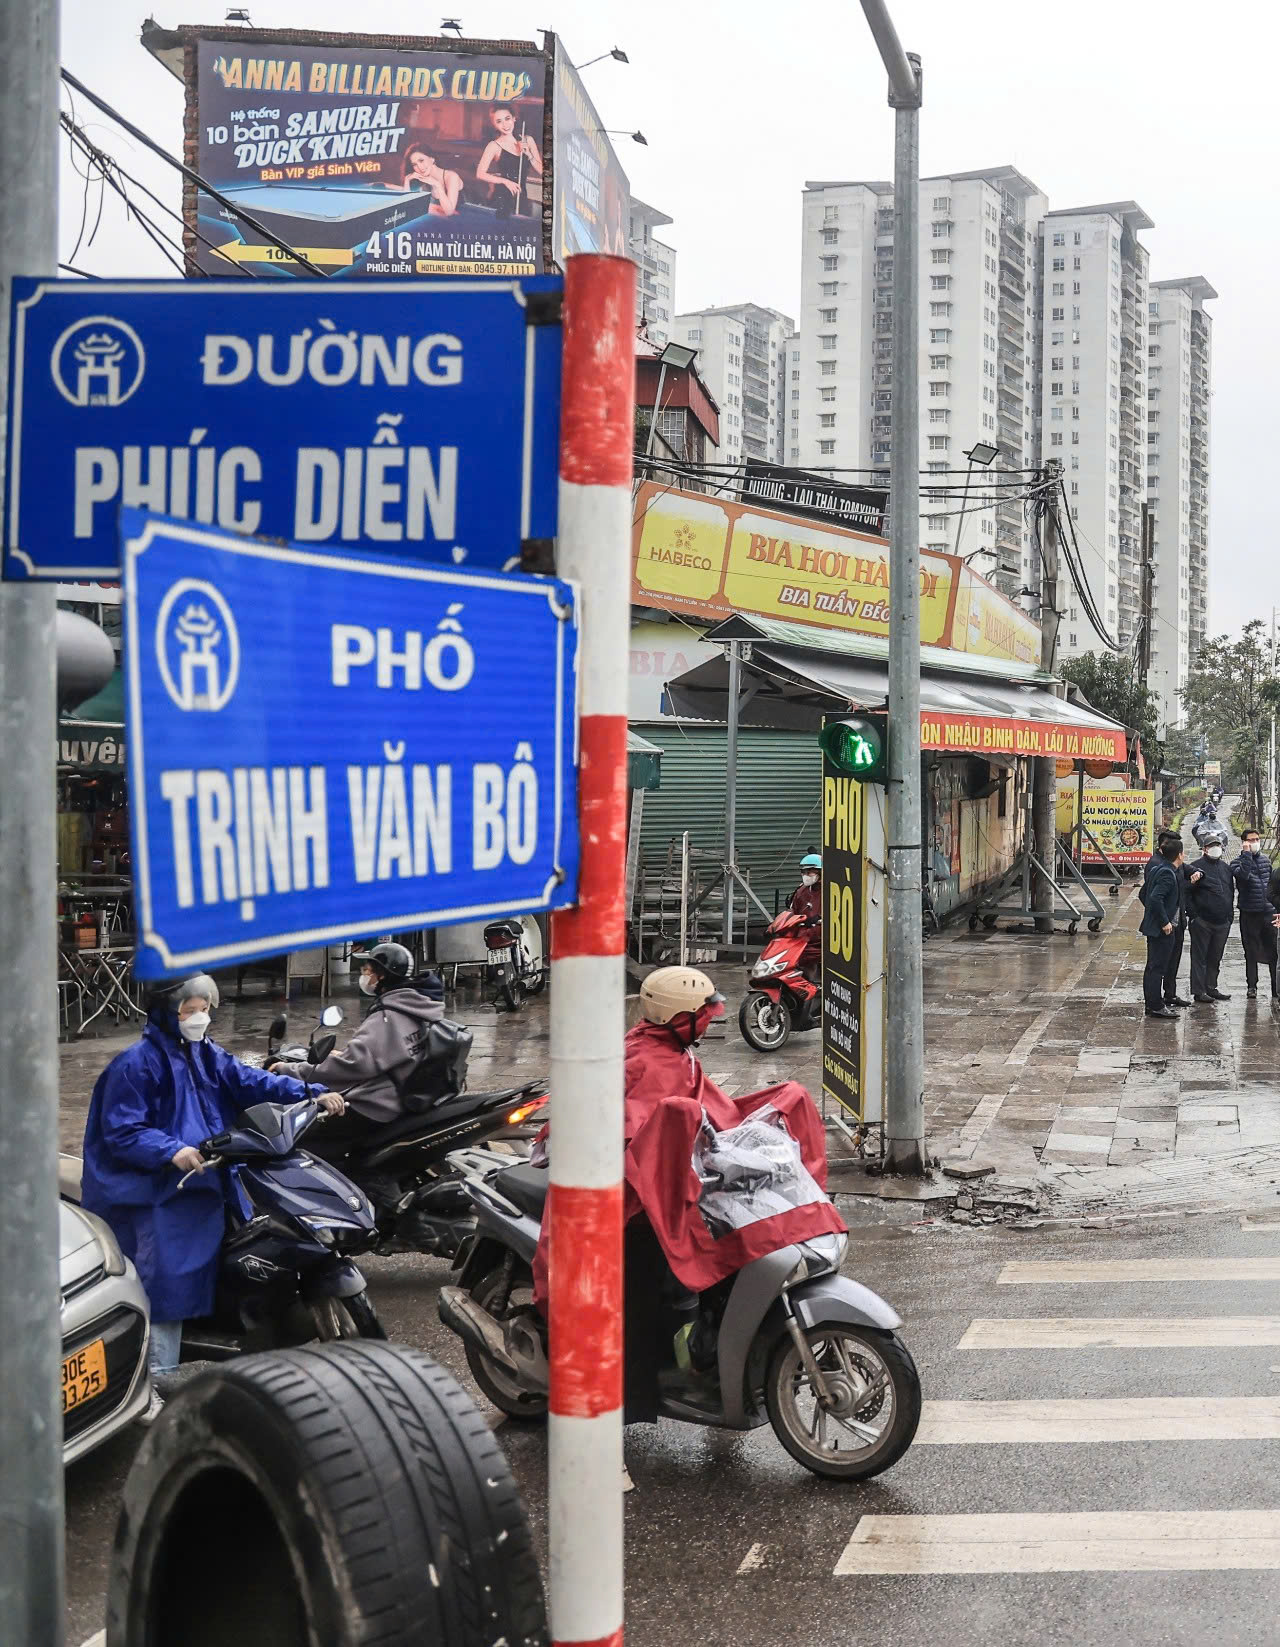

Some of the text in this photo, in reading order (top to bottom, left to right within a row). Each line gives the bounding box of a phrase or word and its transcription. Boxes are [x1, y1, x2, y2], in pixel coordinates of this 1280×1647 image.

[218, 56, 525, 101] ANNA BILLIARDS CLUB
[230, 106, 280, 123] Hệ thống
[285, 102, 400, 138] SAMURAI
[206, 122, 280, 145] 10 bàn
[233, 128, 405, 169] DUCK KNIGHT
[261, 161, 381, 181] Bàn VIP giá Sinh Viên
[366, 230, 412, 260] 416
[416, 241, 536, 261] NAM TỪ LIÊM, HÀ NỘI
[366, 261, 412, 274] PHÚC DIỄN
[446, 264, 459, 273] ĐẶT
[474, 264, 530, 274] 0945.97.1111
[201, 318, 463, 386] ĐƯỜNG
[74, 413, 459, 541] PHÚC DIỄN
[650, 547, 712, 570] HABECO
[746, 533, 795, 569] BIA
[797, 545, 850, 580] HƠI
[852, 555, 890, 588] HÀ
[779, 586, 890, 622] BIA TUẤN BÉO
[332, 602, 475, 692] PHỐ
[944, 722, 980, 750] NHẬU
[983, 724, 1014, 749] BÌNH
[1016, 727, 1042, 753] DÂN,
[1045, 727, 1064, 753] LẨU
[1066, 731, 1079, 754] VÀ
[1081, 733, 1115, 757] NƯỚNG
[1097, 807, 1120, 815] NGON
[1122, 808, 1128, 816] 4
[1129, 806, 1147, 816] MÙA
[161, 740, 538, 922] TRỊNH VĂN BÔ
[830, 867, 854, 961] BÒ
